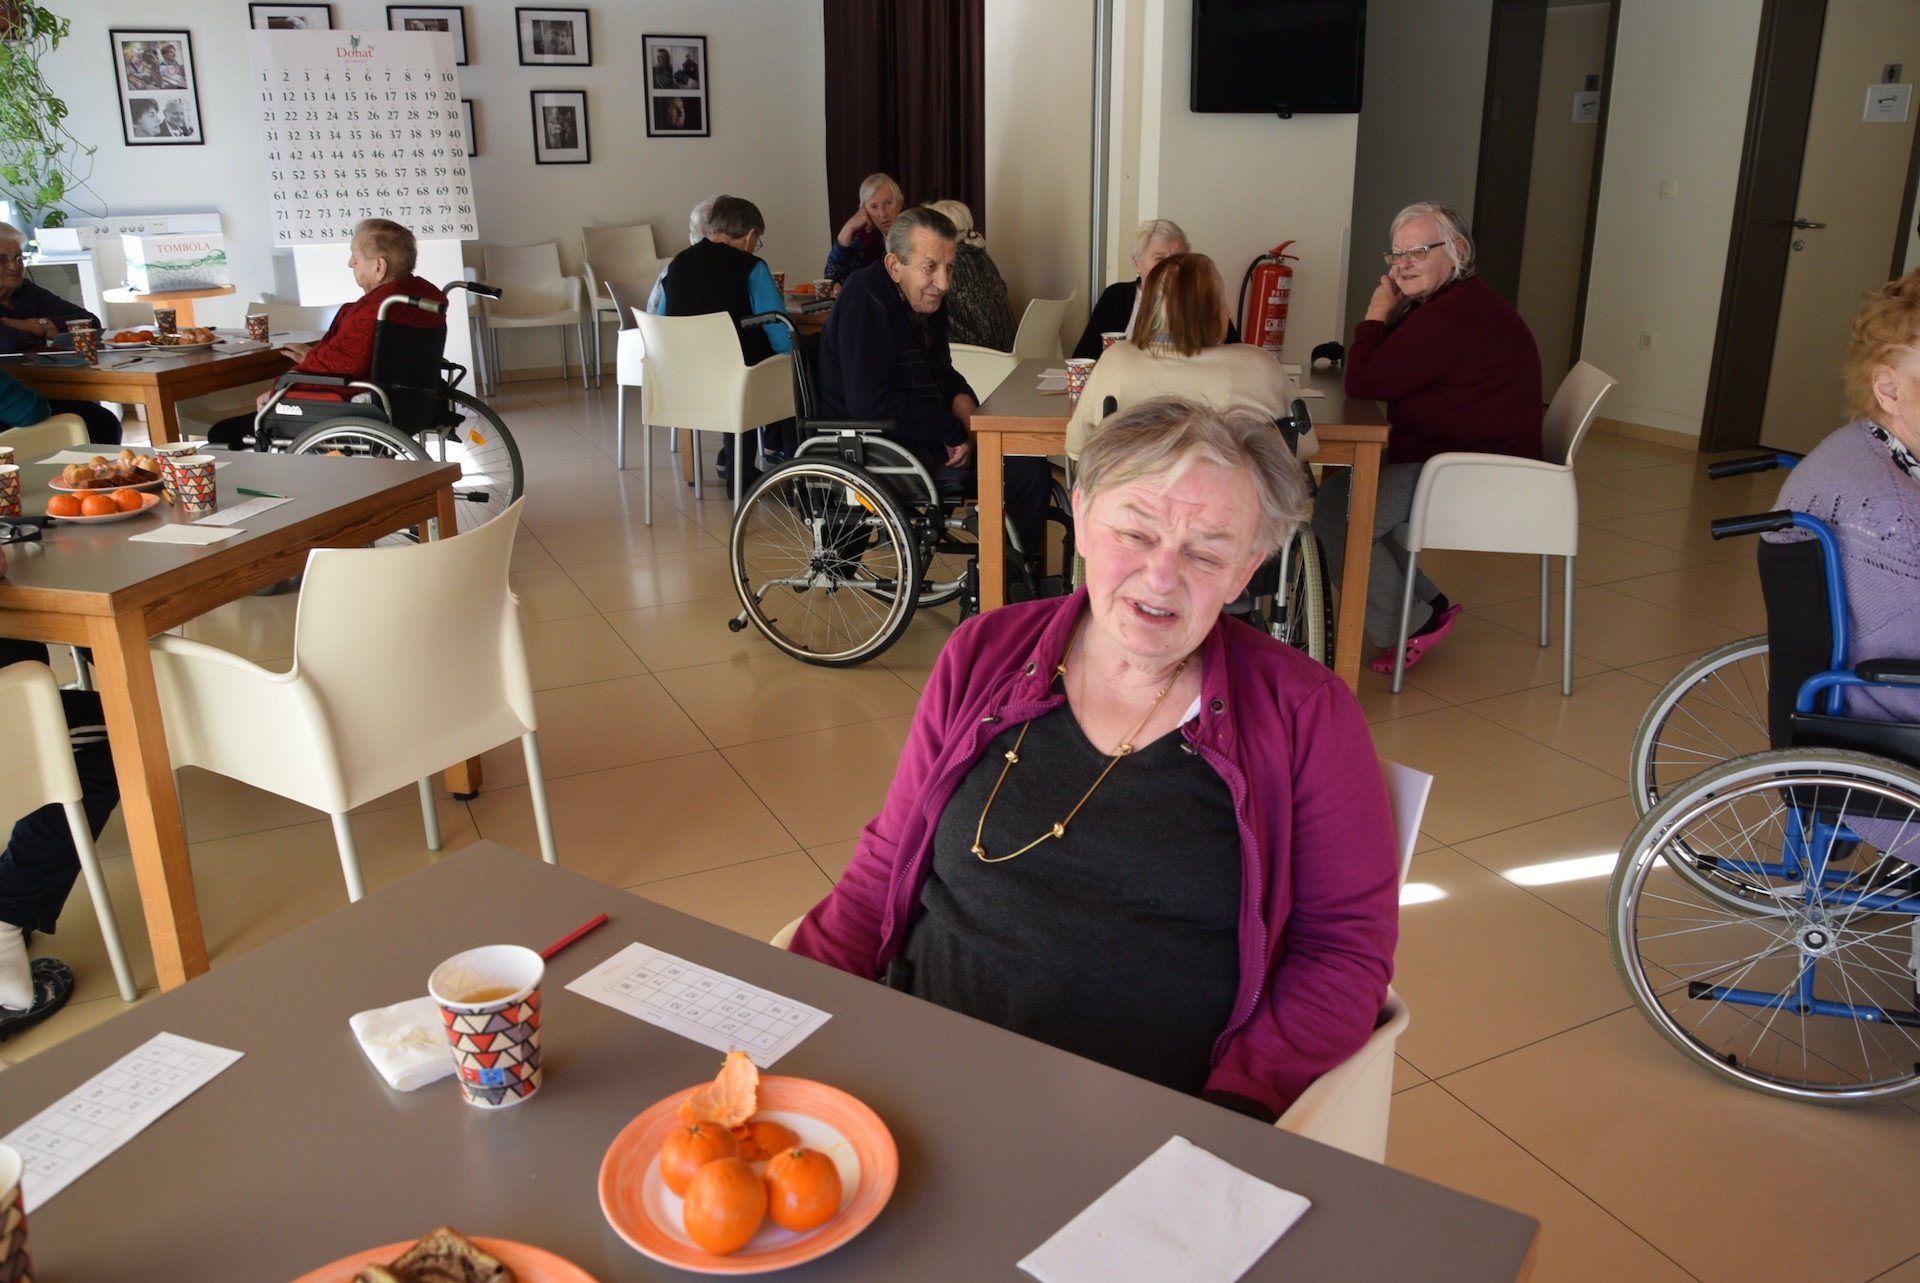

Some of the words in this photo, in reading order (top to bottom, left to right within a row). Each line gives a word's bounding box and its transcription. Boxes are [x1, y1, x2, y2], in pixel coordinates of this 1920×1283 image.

[262, 73, 268, 82] 1
[282, 73, 291, 82] 2
[303, 73, 311, 82] 3
[322, 73, 332, 82] 4
[344, 73, 352, 82] 5
[364, 73, 372, 82] 6
[384, 73, 391, 82] 7
[404, 73, 412, 82] 8
[423, 73, 432, 82] 9
[441, 73, 454, 83] 10
[261, 93, 273, 102] 11
[282, 92, 296, 102] 12
[303, 92, 316, 102] 13
[324, 92, 336, 101] 14
[344, 92, 357, 102] 15
[364, 92, 378, 101] 16
[384, 92, 397, 102] 17
[405, 92, 417, 101] 18
[424, 92, 437, 101] 19
[443, 92, 456, 101] 20
[264, 112, 276, 122] 21
[284, 112, 299, 121] 22
[305, 112, 319, 121] 23
[326, 111, 339, 121] 24
[346, 111, 360, 121] 25
[367, 111, 380, 121] 26
[387, 111, 400, 121] 27
[407, 111, 420, 120] 28
[427, 111, 440, 120] 29
[447, 111, 459, 120] 30
[266, 132, 278, 142] 31
[288, 131, 301, 141] 32
[308, 131, 321, 141] 33
[329, 131, 342, 140] 34
[349, 131, 362, 140] 35
[370, 130, 383, 140] 36
[390, 130, 402, 140] 37
[410, 130, 423, 139] 38
[429, 130, 442, 139] 39
[448, 130, 461, 139] 40
[268, 152, 281, 161] 41
[289, 151, 304, 161] 42
[310, 150, 324, 160] 43
[331, 151, 344, 160] 44
[351, 150, 365, 159] 45
[371, 150, 385, 159] 46
[391, 149, 405, 159] 47
[411, 149, 425, 158] 48
[431, 149, 444, 158] 49
[451, 149, 464, 158] 50
[271, 171, 284, 181] 51
[292, 171, 306, 180] 52
[313, 170, 326, 180] 53
[334, 170, 347, 179] 54
[354, 169, 367, 179] 55
[374, 169, 388, 178] 56
[394, 168, 407, 178] 57
[414, 168, 427, 177] 58
[434, 168, 447, 177] 59
[452, 168, 466, 177] 60
[273, 192, 286, 201] 61
[294, 190, 309, 200] 62
[315, 189, 329, 199] 63
[335, 190, 349, 198] 64
[356, 189, 370, 198] 65
[376, 189, 391, 197] 66
[396, 187, 410, 197] 67
[416, 187, 430, 196] 68
[436, 187, 449, 196] 69
[455, 186, 469, 196] 70
[276, 211, 289, 220] 71
[297, 210, 311, 219] 72
[317, 209, 332, 219] 73
[338, 209, 352, 218] 74
[358, 208, 373, 218] 75
[378, 207, 394, 217] 76
[399, 207, 412, 216] 77
[418, 206, 433, 216] 78
[438, 206, 452, 215] 79
[457, 206, 471, 214] 80
[279, 231, 292, 240] 81
[299, 229, 314, 239] 82
[320, 229, 334, 238] 83
[341, 229, 354, 237] 84
[421, 225, 435, 234] 88
[441, 225, 454, 233] 89
[460, 224, 474, 233] 90
[156, 242, 212, 253] TOMBOLA
